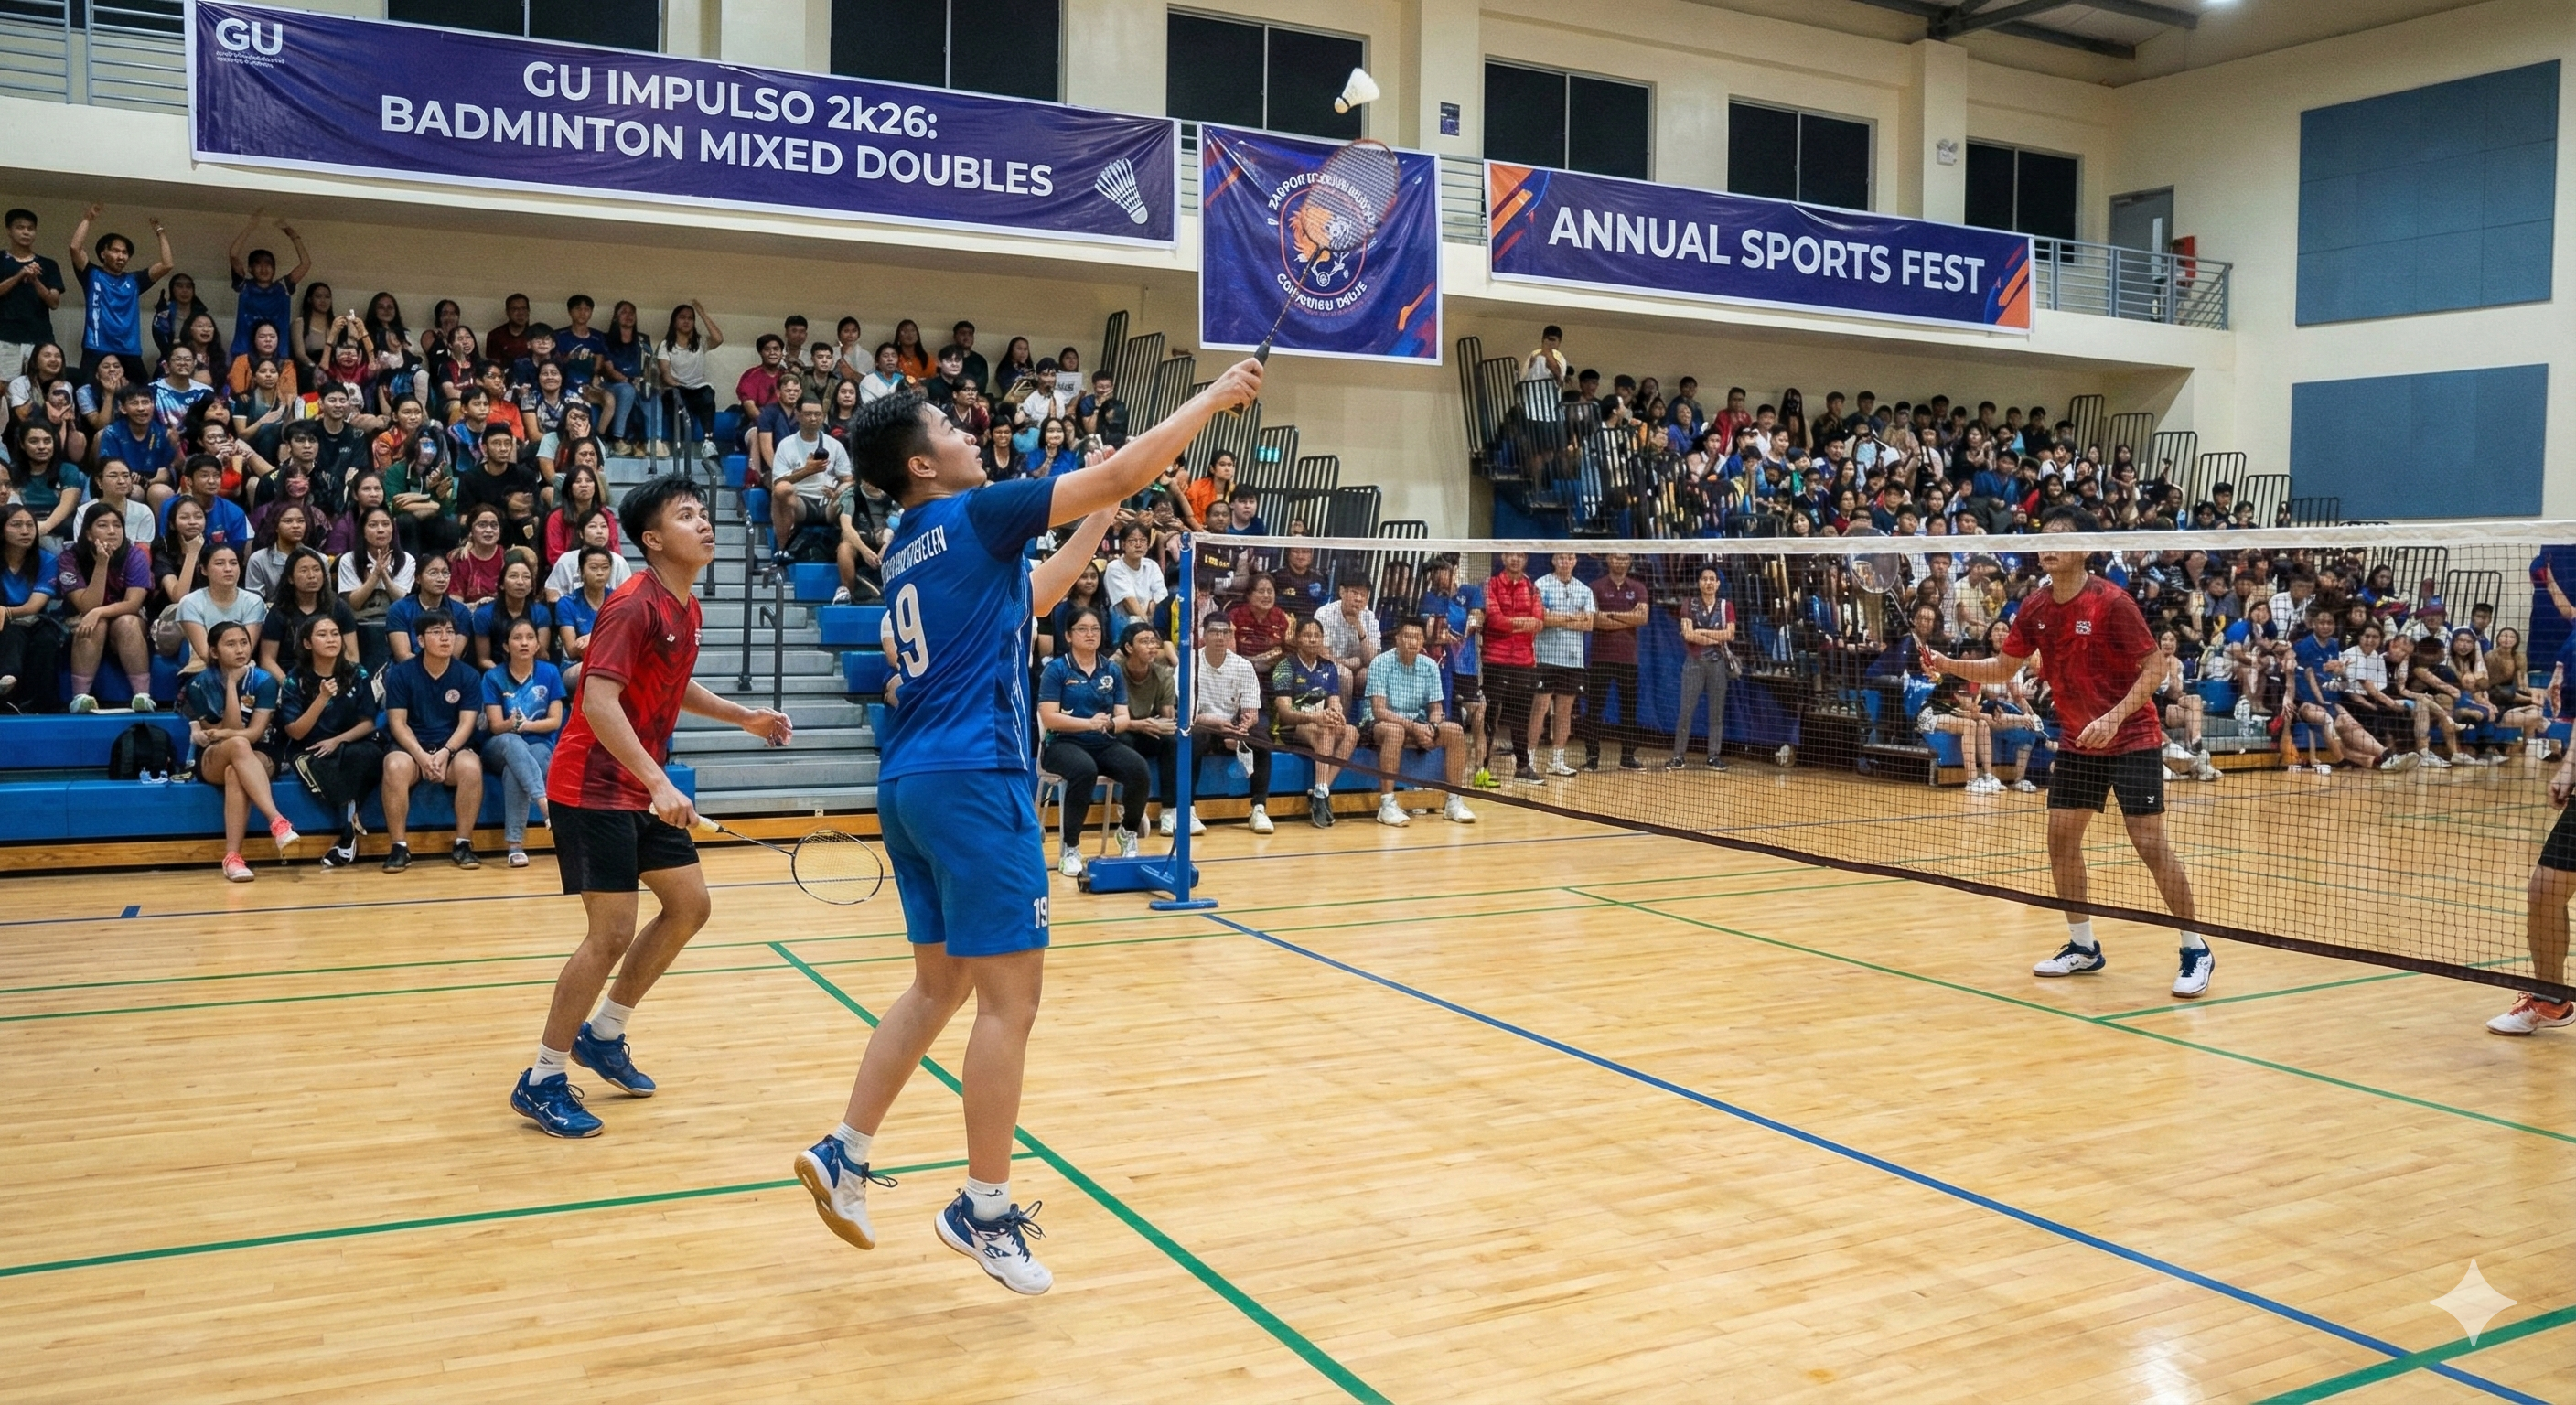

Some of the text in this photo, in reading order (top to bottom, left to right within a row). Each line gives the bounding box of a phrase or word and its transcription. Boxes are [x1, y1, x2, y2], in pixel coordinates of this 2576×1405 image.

[216, 17, 284, 56] GU
[523, 60, 938, 140] GU IMPULSO 2k26:
[381, 94, 1054, 197] BADMINTON MIXED DOUBLES
[1548, 206, 1985, 294] ANNUAL SPORTS FEST
[896, 583, 929, 678] 9
[1033, 896, 1047, 928] 19
